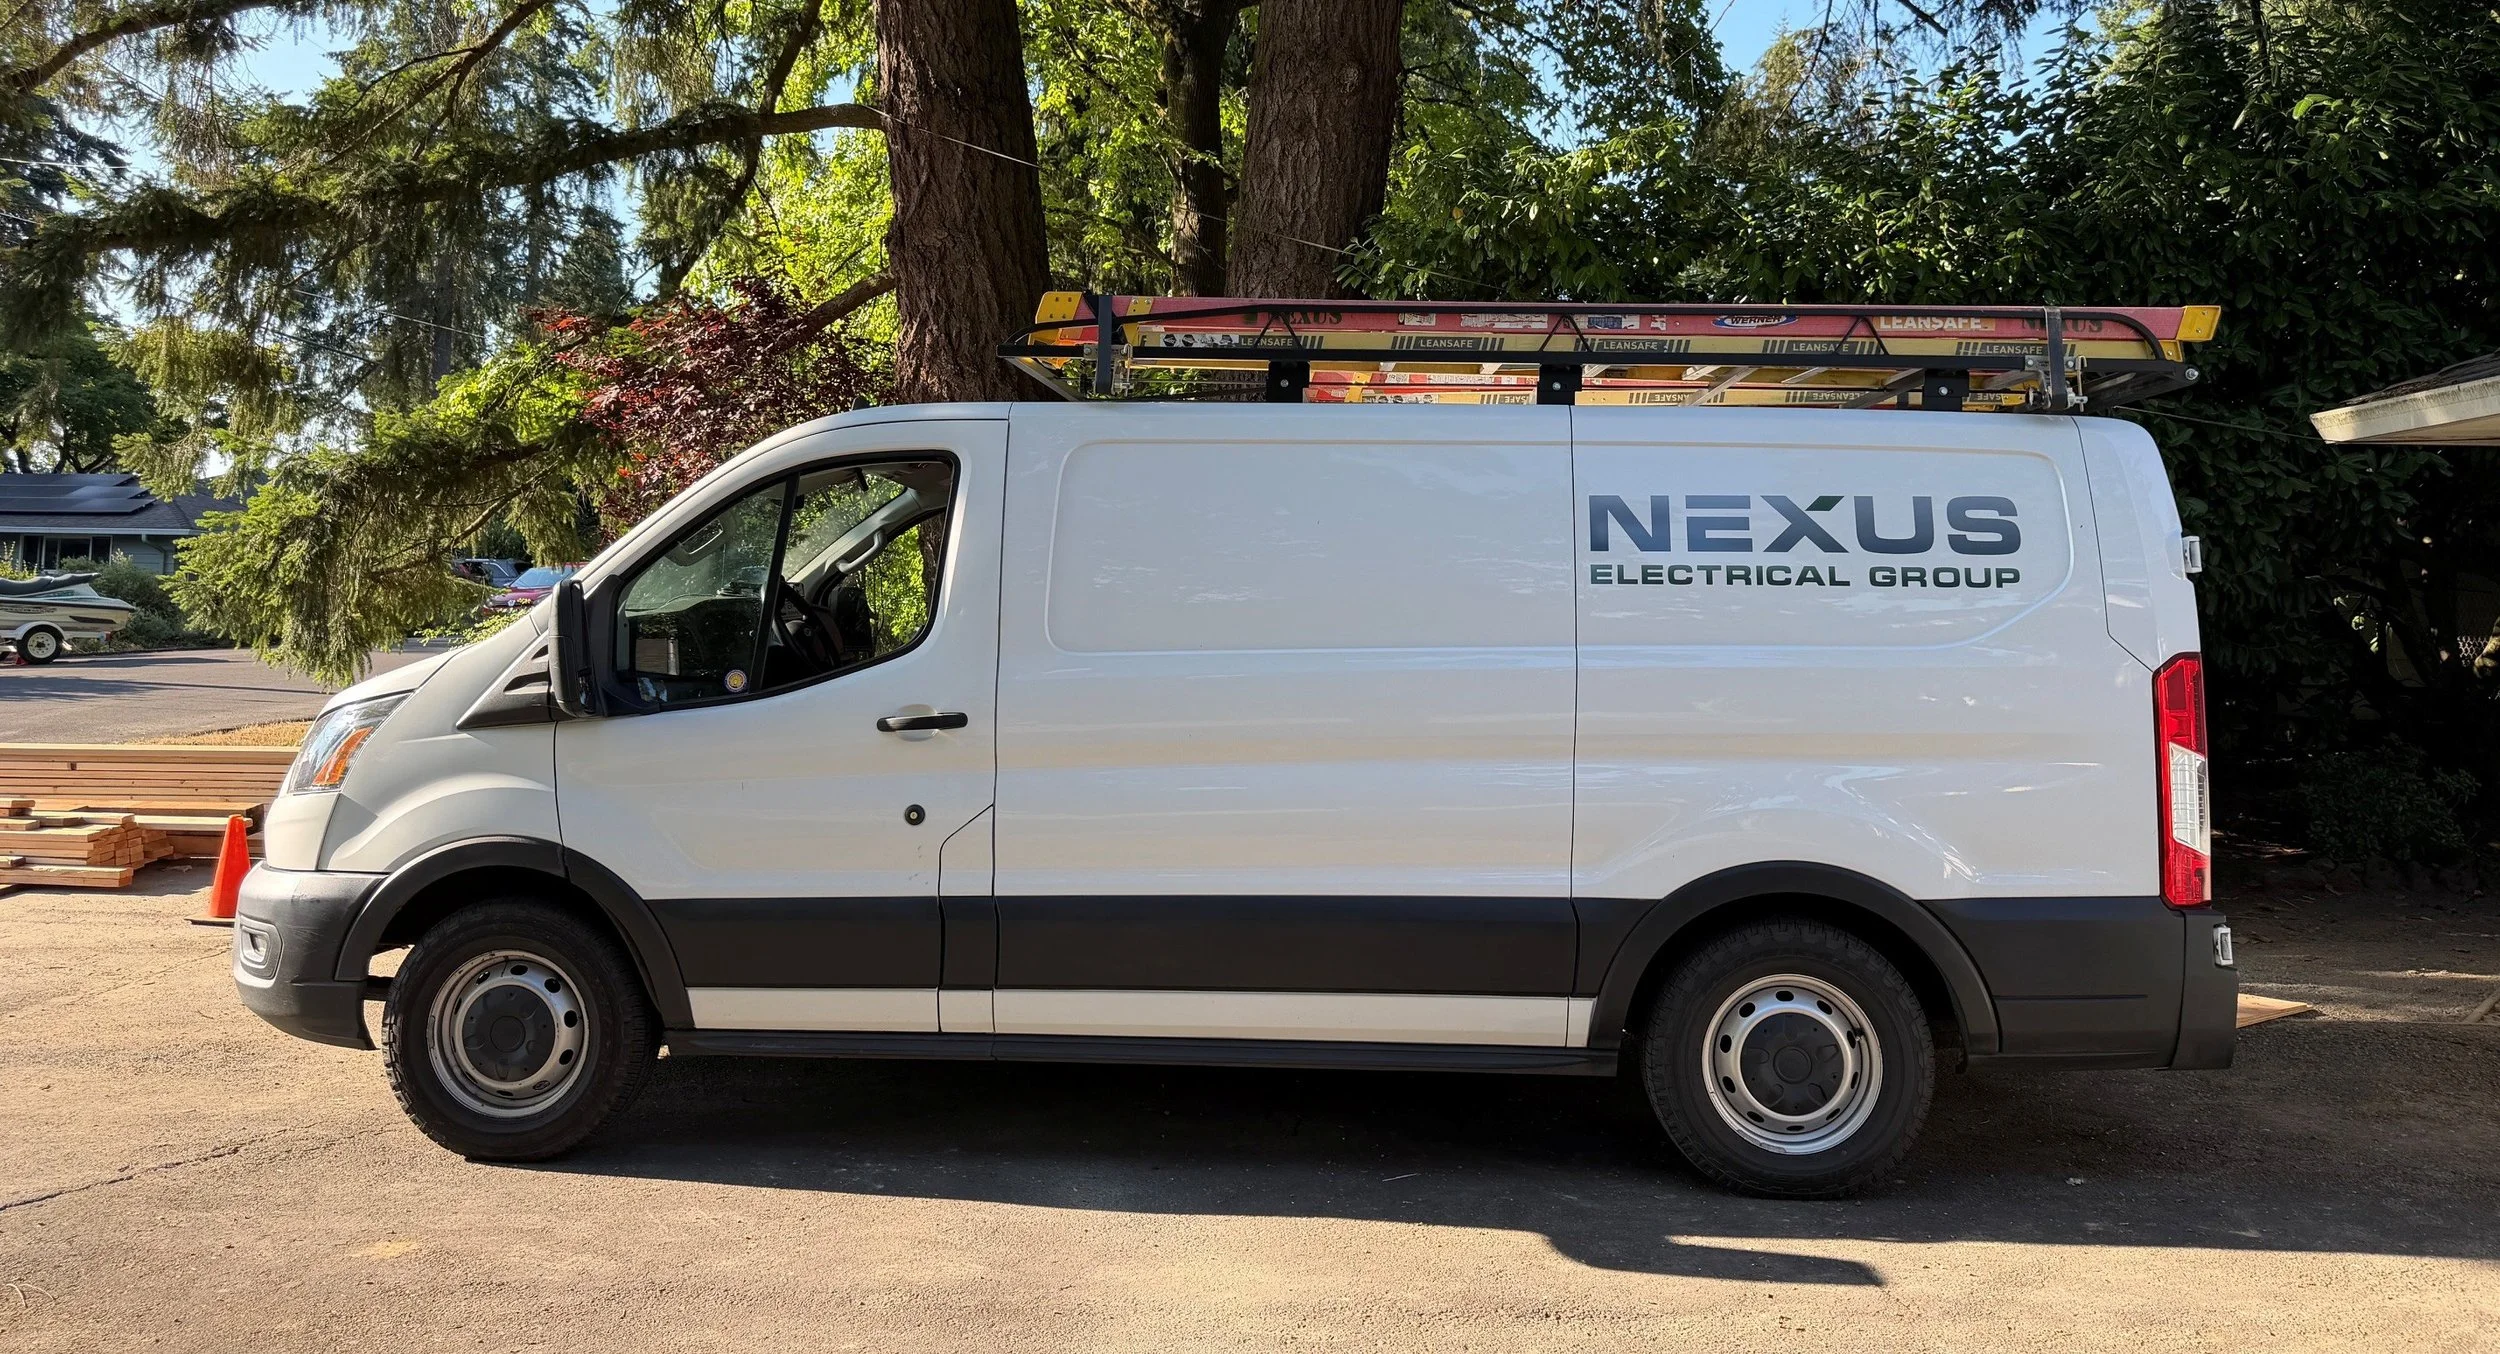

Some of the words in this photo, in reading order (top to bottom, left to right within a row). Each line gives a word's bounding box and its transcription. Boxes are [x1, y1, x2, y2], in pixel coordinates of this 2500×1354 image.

[1730, 314, 1783, 325] WERNER
[1880, 316, 1982, 330] LEANSAFE
[1420, 338, 1473, 348] LEANSAFE
[1603, 340, 1658, 350] LEANSAFE
[1793, 342, 1849, 352] LEANSAE
[1986, 345, 2043, 355] LEANSAFE
[1588, 495, 2022, 555] NEXUS
[1590, 563, 1851, 587] ELECTRICAL
[1868, 566, 2021, 588] GROUP
